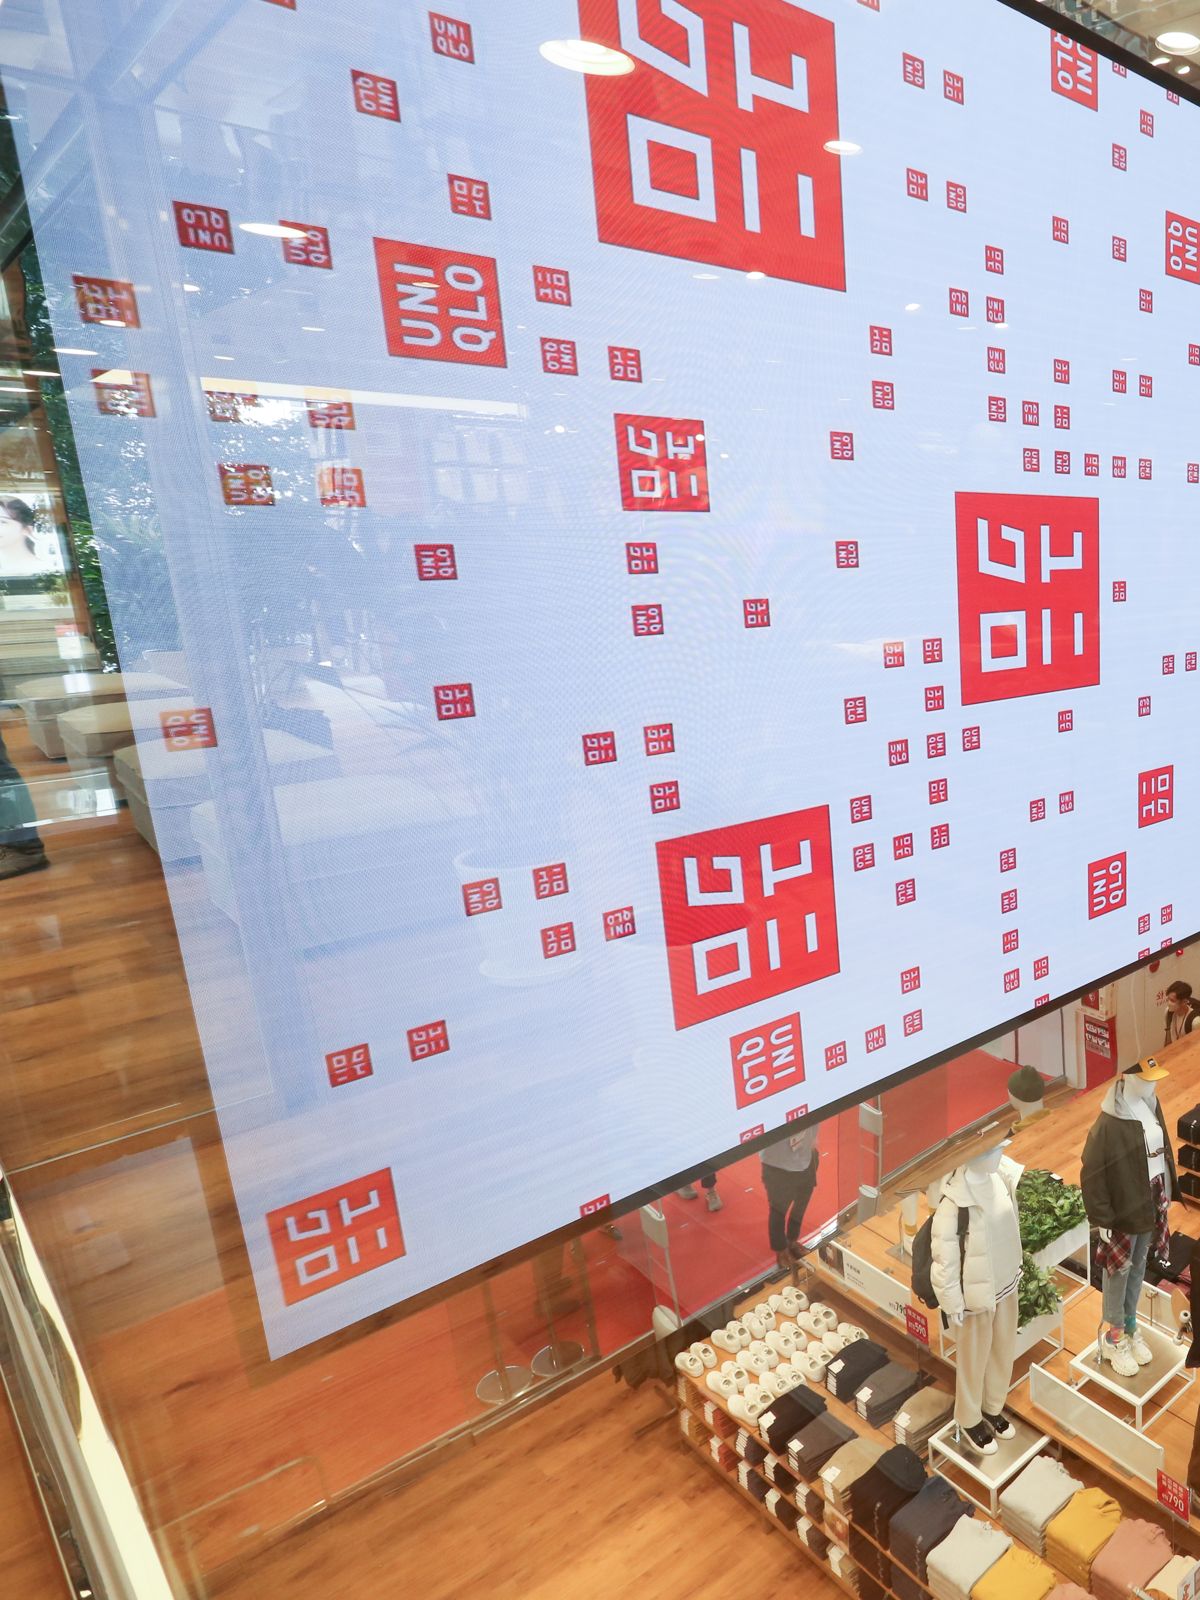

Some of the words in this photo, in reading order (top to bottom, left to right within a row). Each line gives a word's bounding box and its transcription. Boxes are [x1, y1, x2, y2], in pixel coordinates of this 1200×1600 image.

[434, 18, 464, 40] UNI
[437, 36, 469, 58] QLO
[356, 77, 377, 111] QLO
[377, 81, 394, 113] UNI
[182, 208, 224, 229] QLO
[188, 228, 228, 247] UNI
[1168, 221, 1183, 271] QLO
[1185, 227, 1198, 272] UNI
[394, 264, 441, 346] UNI
[445, 265, 496, 352] QLO
[544, 342, 560, 370] QLO
[560, 344, 573, 369] UNI
[421, 551, 437, 577] UNI
[436, 548, 454, 577] QLO
[482, 883, 499, 908] QLO
[1093, 869, 1107, 911] UNI
[1109, 861, 1124, 904] QLO
[737, 1037, 768, 1095] QLO
[770, 1024, 796, 1079] UNI
